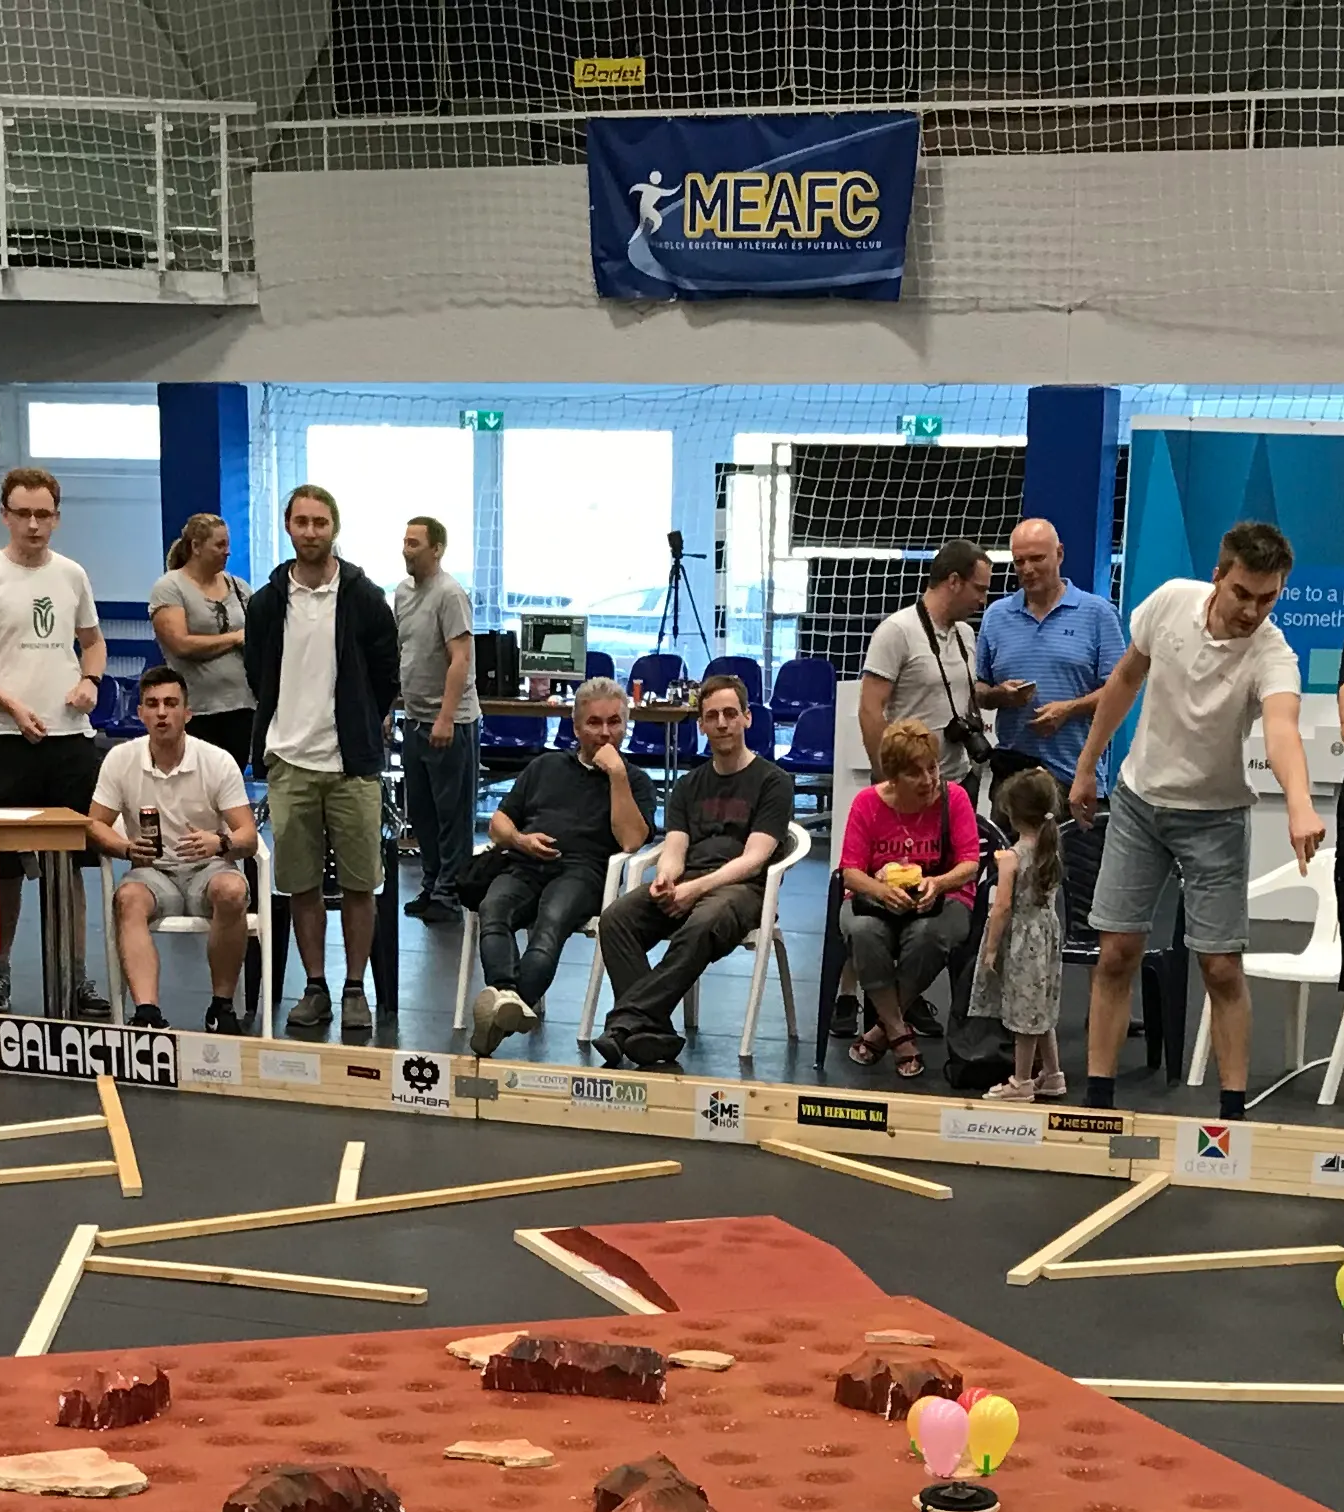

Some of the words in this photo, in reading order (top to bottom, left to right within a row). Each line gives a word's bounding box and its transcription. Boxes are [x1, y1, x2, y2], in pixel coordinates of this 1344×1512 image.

[579, 63, 642, 82] Bodet
[684, 171, 880, 239] MEAFC
[855, 240, 882, 250] CLUB
[1306, 586, 1322, 602] to
[1327, 589, 1338, 603] a
[572, 1078, 646, 1103] chipCAD
[719, 1103, 739, 1118] ME
[801, 1103, 823, 1117] VIVA
[824, 1106, 868, 1122] ELEKTRIK
